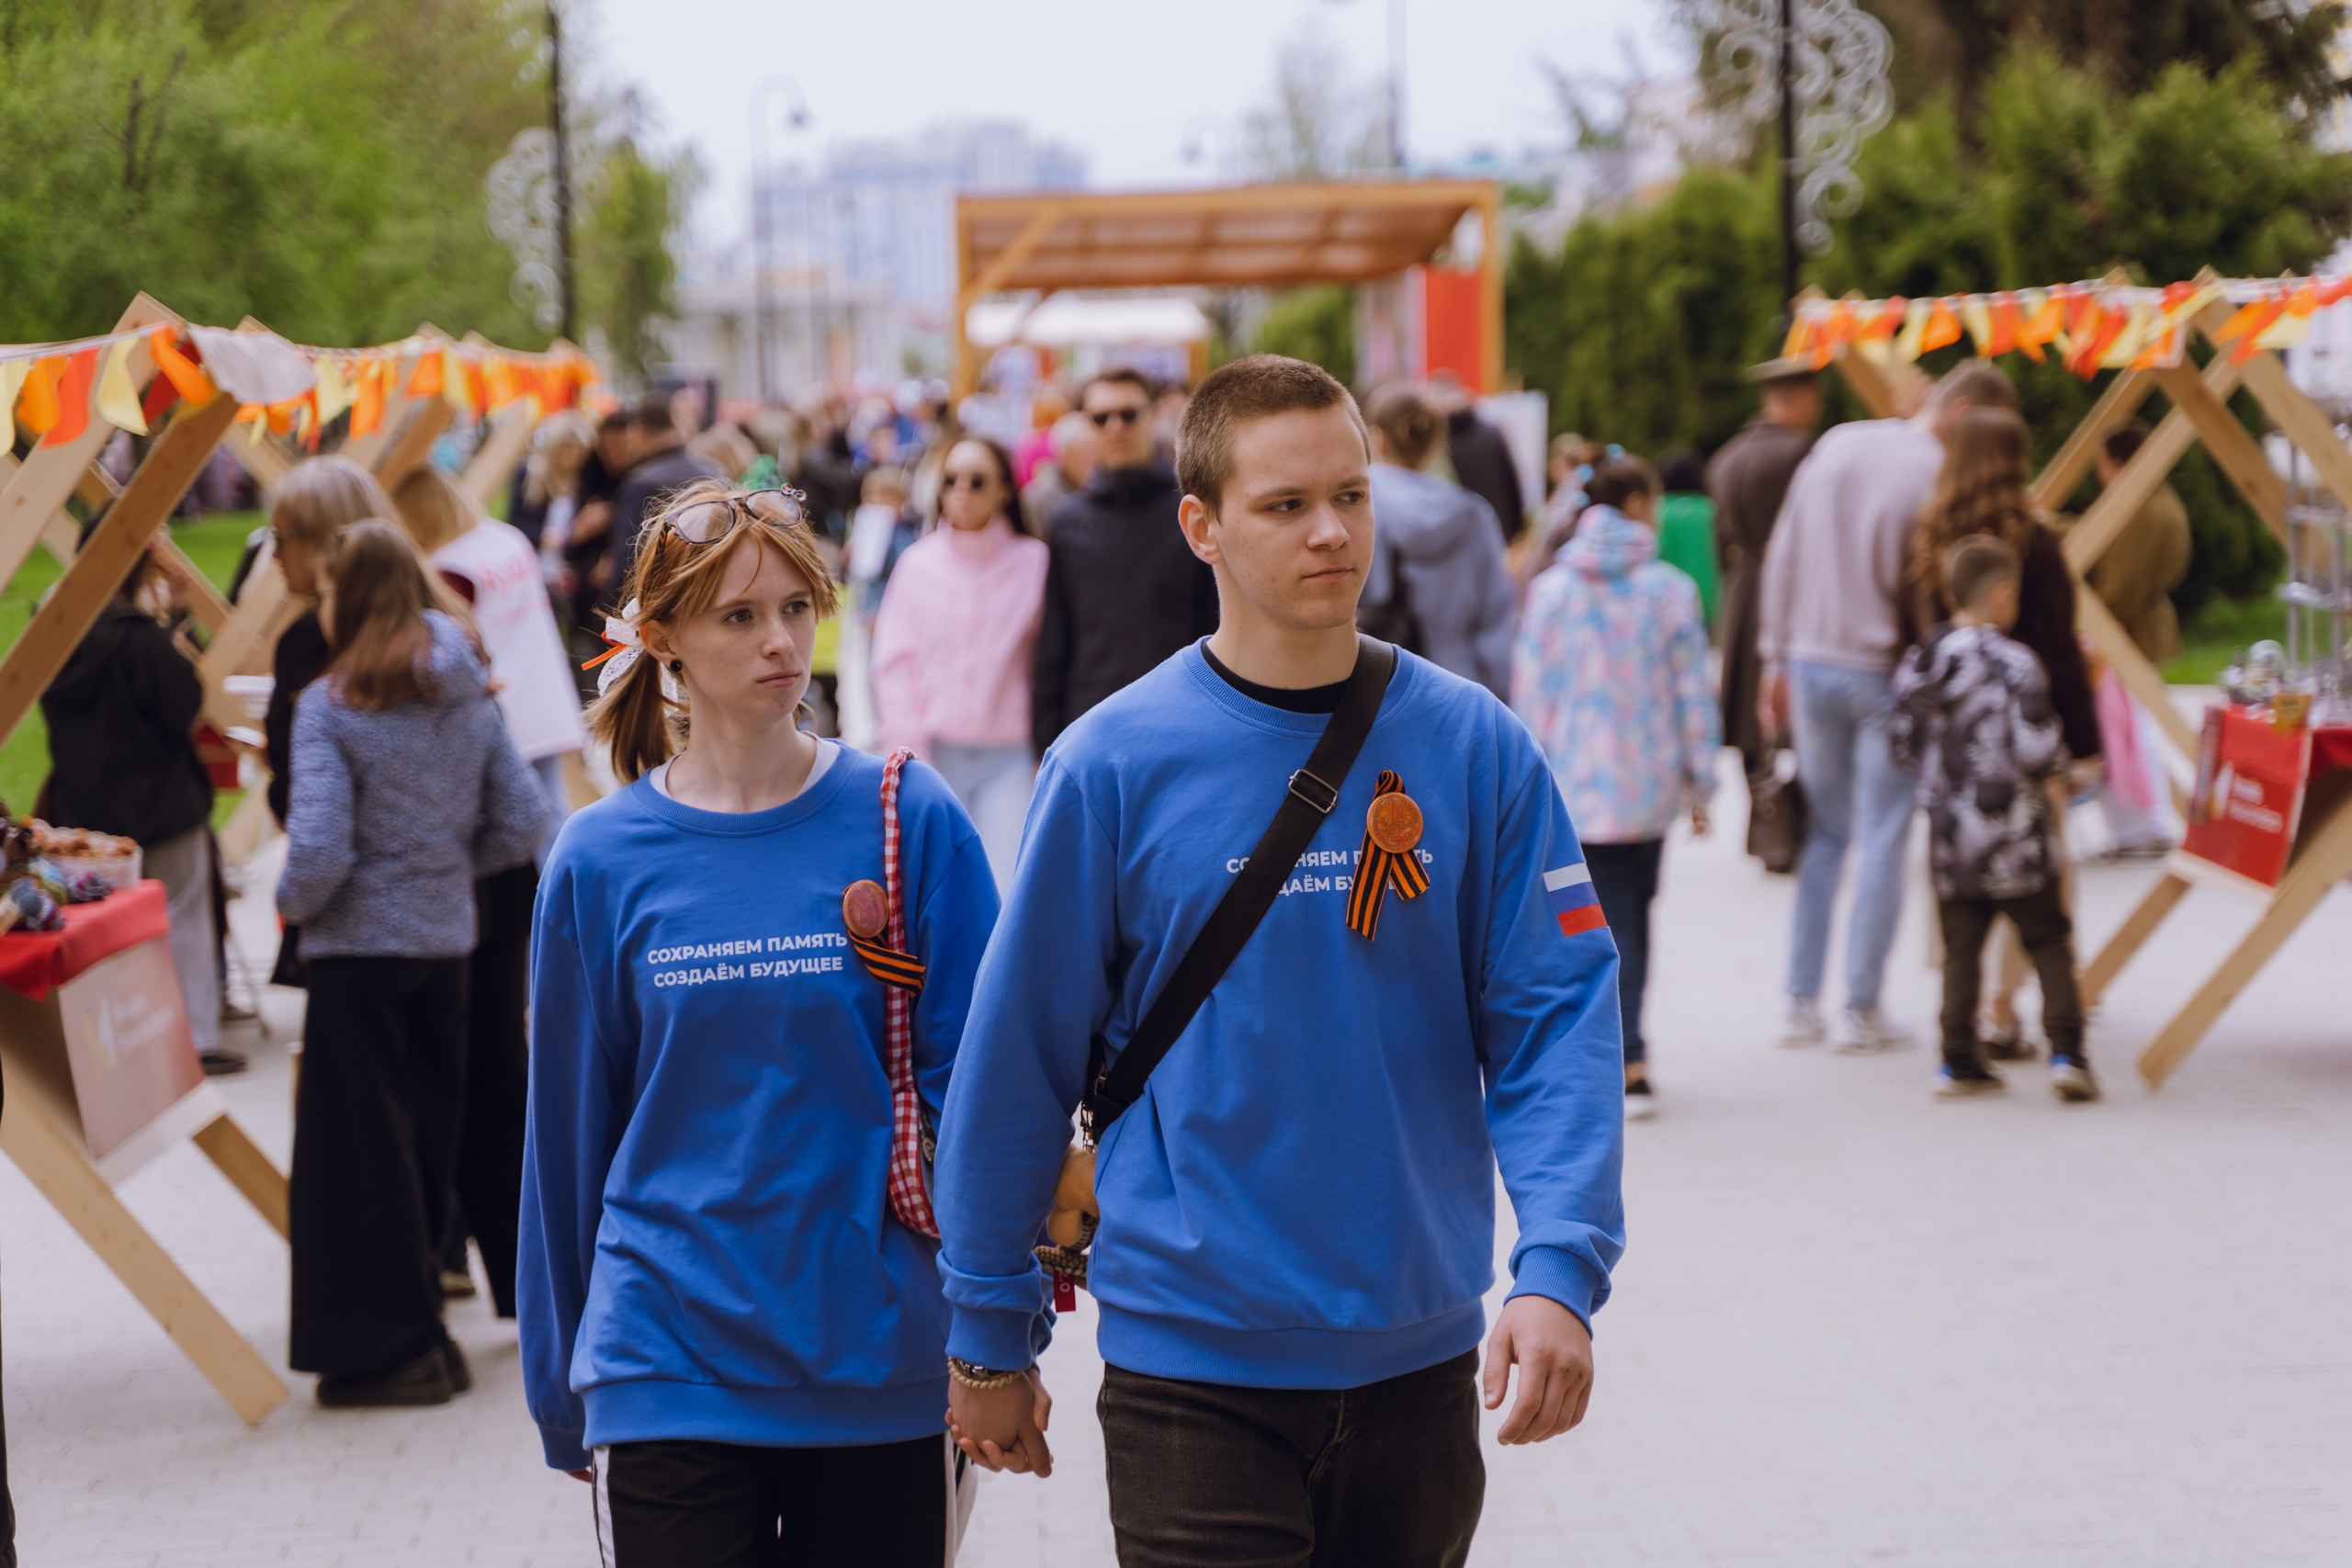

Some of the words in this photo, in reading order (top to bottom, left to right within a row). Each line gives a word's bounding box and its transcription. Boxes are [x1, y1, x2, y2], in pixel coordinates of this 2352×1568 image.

[1226, 851, 1348, 874] СОНЯЕМ
[647, 939, 763, 964] СОХРАНЯЕМ
[767, 932, 848, 952] ПАМЯТЬ
[653, 963, 745, 987] СОЗДАЁМ
[749, 956, 843, 977] БУДУЩЕЕ
